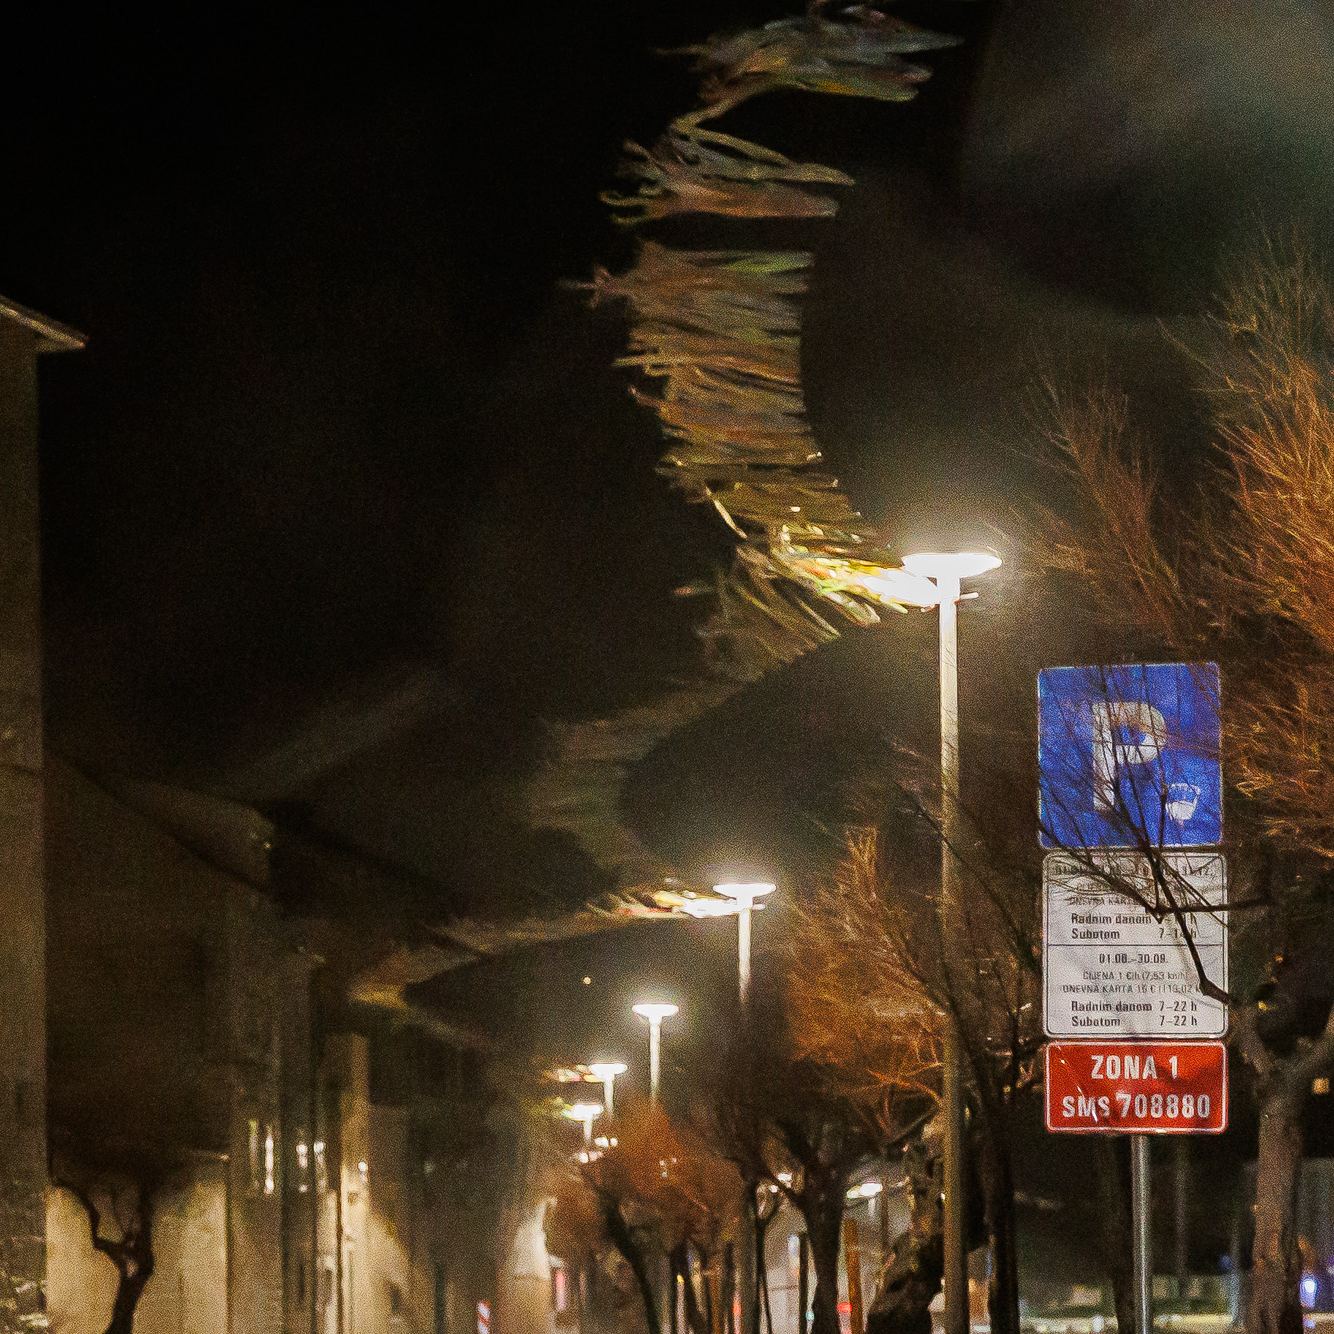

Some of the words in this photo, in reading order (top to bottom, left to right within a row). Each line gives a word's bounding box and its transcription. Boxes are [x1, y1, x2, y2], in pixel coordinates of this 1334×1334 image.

[1092, 702, 1168, 811] P
[1071, 912, 1112, 924] Radnim
[1115, 913, 1152, 924] danom
[1071, 928, 1120, 940] Subotom
[1071, 1000, 1112, 1012] Radnim
[1115, 1001, 1153, 1012] danom
[1191, 1000, 1198, 1012] h
[1071, 1016, 1121, 1027] Subotom
[1191, 1015, 1198, 1026] h
[1090, 1055, 1158, 1080] ZONA
[1168, 1055, 1178, 1079] 1
[1062, 1095, 1111, 1119] SMS
[1115, 1093, 1211, 1120] 708880
